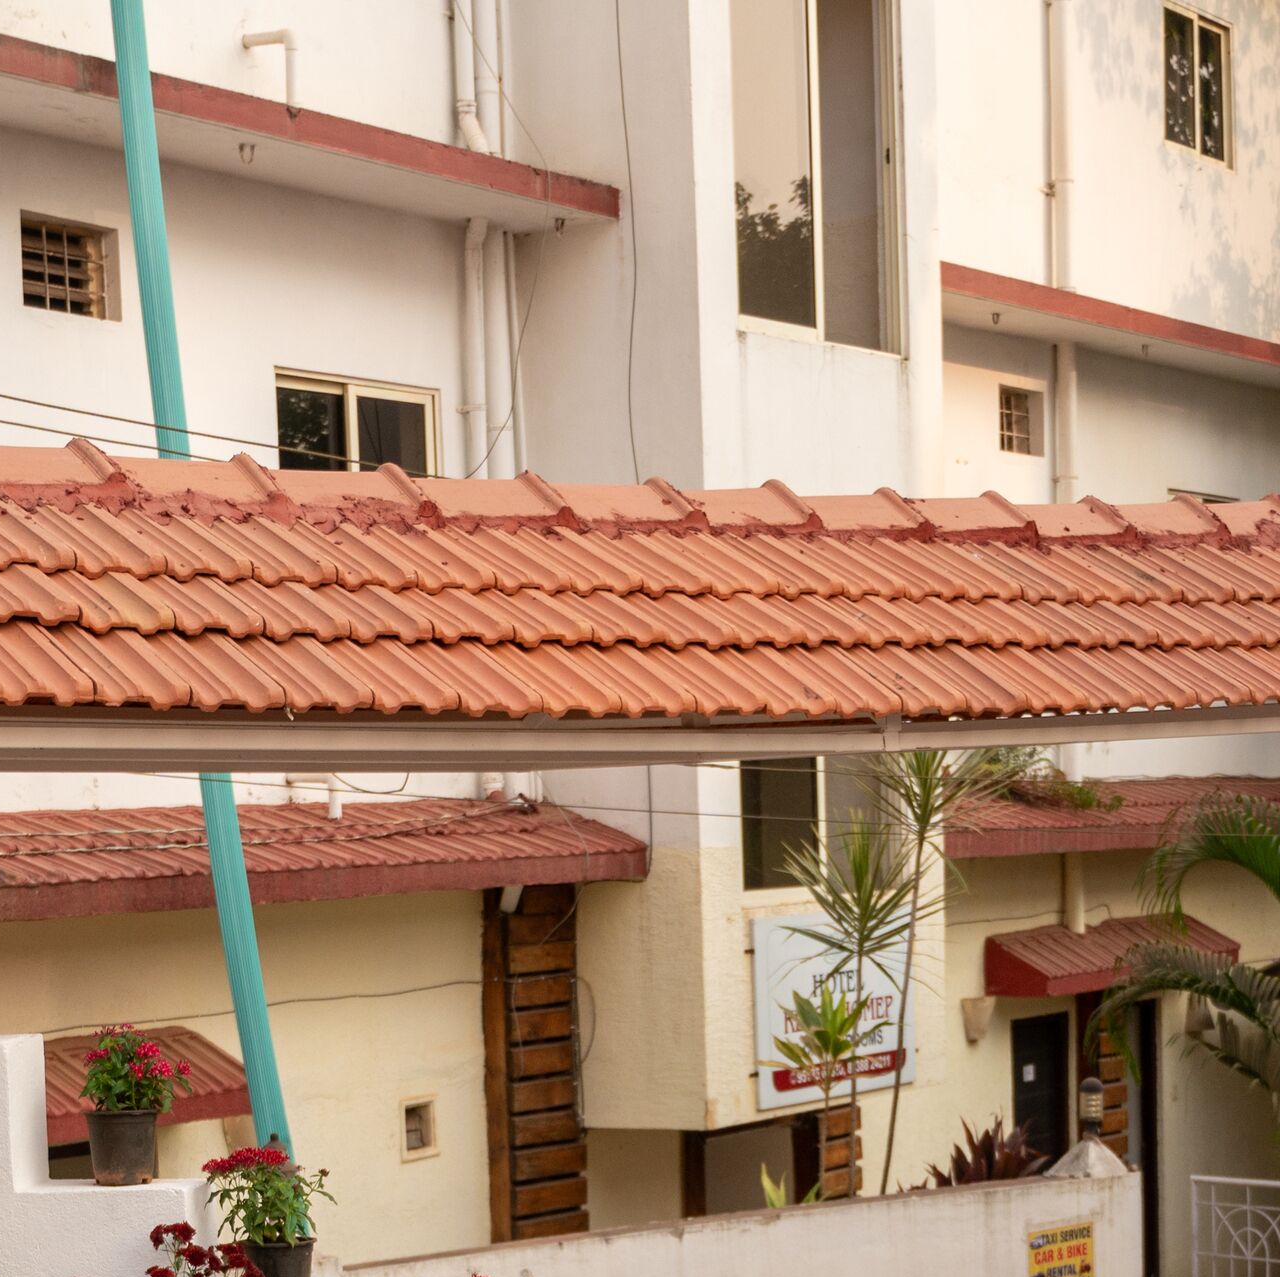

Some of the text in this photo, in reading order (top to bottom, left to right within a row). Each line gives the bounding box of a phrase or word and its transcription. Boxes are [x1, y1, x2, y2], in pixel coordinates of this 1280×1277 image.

[1060, 1225, 1090, 1243] SERVICE
[1034, 1242, 1088, 1265] CAR & BIKE
